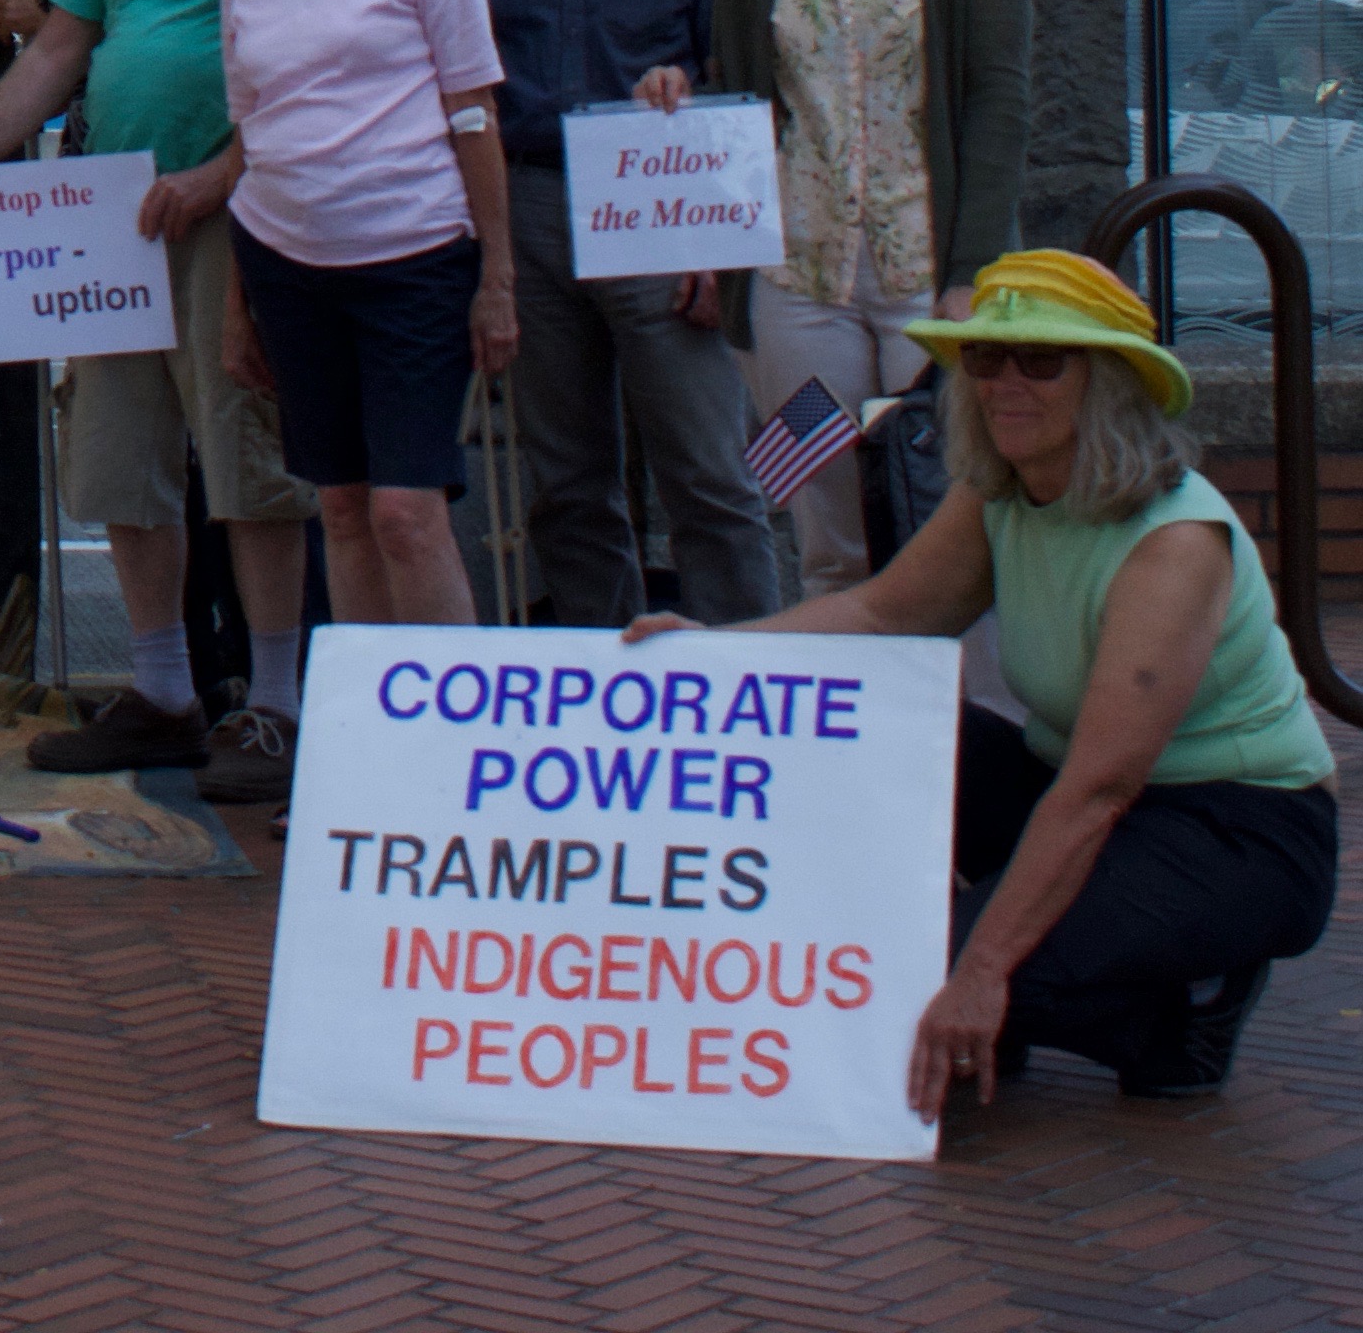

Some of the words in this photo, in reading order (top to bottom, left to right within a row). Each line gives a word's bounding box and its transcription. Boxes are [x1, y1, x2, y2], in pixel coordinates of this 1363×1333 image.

[51, 183, 94, 209] the
[615, 144, 730, 179] Follow
[590, 201, 642, 233] the
[650, 194, 765, 232] Money
[32, 283, 152, 322] uption
[377, 660, 863, 740] CORPORATE
[464, 746, 773, 820] POWER
[327, 829, 770, 912] TRAMPLES
[380, 925, 875, 1011] INDIGENOUS
[412, 1018, 792, 1098] PEOPLES
